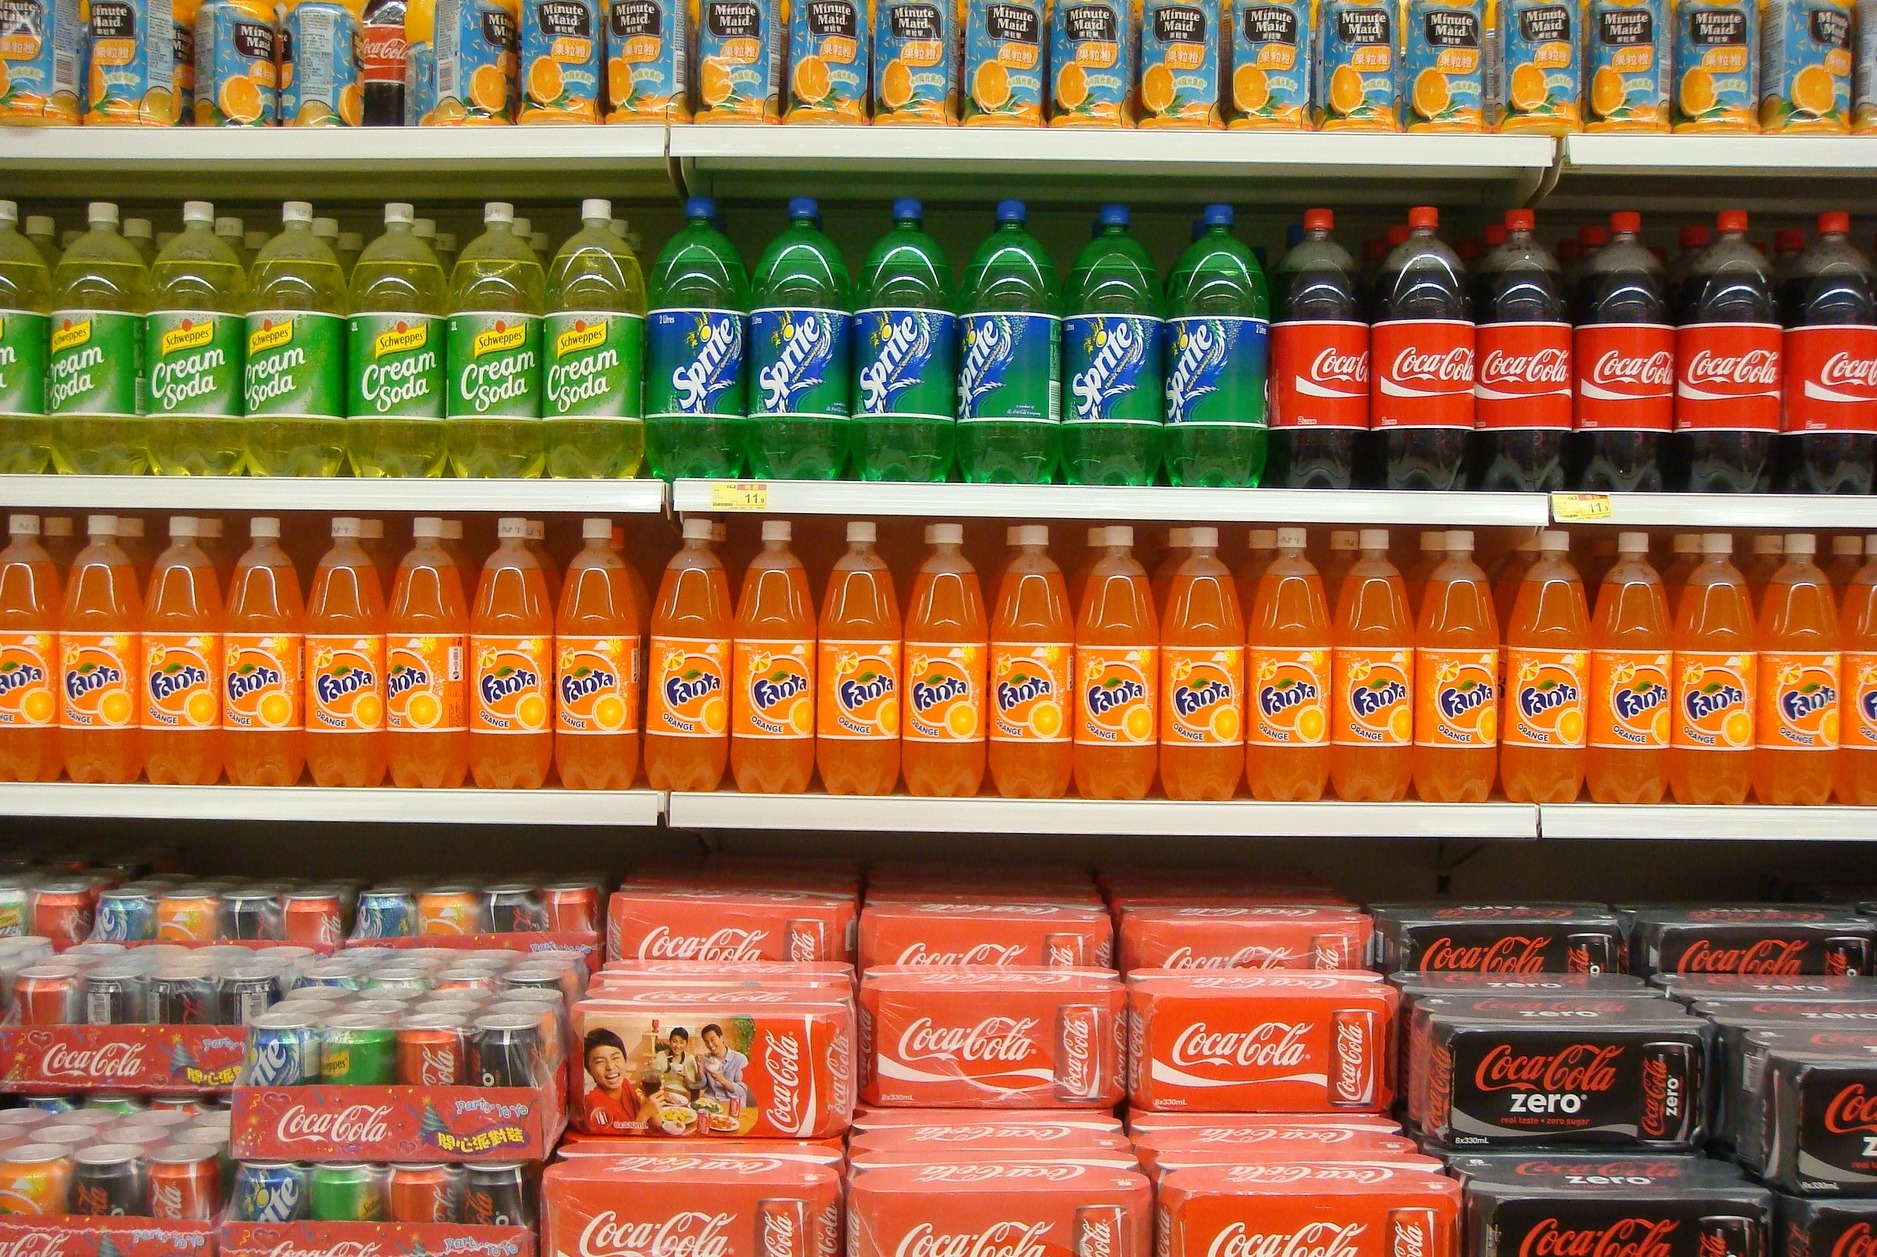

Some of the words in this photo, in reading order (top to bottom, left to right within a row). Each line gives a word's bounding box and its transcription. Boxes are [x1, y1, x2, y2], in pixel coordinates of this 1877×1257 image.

[543, 5, 584, 15] Minute
[616, 4, 655, 14] Minute
[715, 5, 756, 15] Minute
[813, 4, 851, 14] Minute
[893, 7, 934, 18] Minute
[993, 7, 1033, 20] Minute
[1070, 8, 1110, 20] Minute
[1160, 9, 1200, 21] Minute
[1250, 10, 1292, 22] Minute
[1342, 12, 1386, 23] Minute
[1526, 10, 1566, 21] Minute
[1604, 13, 1648, 24] Minute
[1696, 13, 1741, 24] Minute
[549, 15, 579, 26] Maid
[620, 14, 649, 26] Maid
[719, 15, 750, 27] Maid
[817, 14, 846, 26] Maid
[898, 18, 928, 29] Maid
[997, 18, 1028, 30] Maid
[1074, 19, 1105, 30] Maid
[1163, 20, 1194, 31] Maid
[1255, 21, 1287, 32] Maid
[1349, 23, 1379, 35] Maid
[1430, 14, 1473, 25] Minute
[1531, 20, 1563, 32] Maid
[1435, 24, 1468, 36] Maid
[1609, 25, 1643, 35] Maid
[1700, 24, 1735, 35] Maid
[554, 45, 587, 57] 果粒橙
[1003, 50, 1034, 62] 果粒橙
[1168, 51, 1199, 63] 果粒橙
[1355, 54, 1389, 66] 果粒橙
[1616, 55, 1649, 66] 果粒橙
[1440, 56, 1473, 68] 果粒橙
[660, 315, 665, 324] 2
[165, 329, 210, 347] Schweppes
[251, 328, 288, 346] Schweppes
[379, 330, 424, 350] Schweppes
[478, 330, 523, 349] Schweppes
[560, 329, 605, 348] Schweppes
[672, 318, 733, 410] Sprite
[760, 315, 820, 408] Sprite
[860, 315, 918, 408] Sprite
[1073, 319, 1132, 411] Sprite
[1166, 319, 1215, 410] Sprite
[1311, 347, 1369, 382] Coca-C
[1481, 347, 1568, 384] Coca-Cola
[1688, 350, 1777, 384] Coca-Cola
[1821, 352, 1877, 386] Coca-C
[152, 348, 226, 399] Cream
[245, 347, 306, 397] Cream
[362, 351, 436, 401] Cream
[461, 351, 536, 400] Cream
[547, 349, 619, 402] Cream
[164, 373, 217, 410] Soda
[250, 372, 296, 411] Soda
[377, 376, 430, 412] Soda
[475, 375, 528, 412] Soda
[558, 373, 610, 412] Soda
[66, 664, 120, 700] Fanta
[150, 665, 206, 701] Fanta
[227, 666, 279, 702] Fanta
[317, 668, 372, 704] Fanta
[481, 669, 536, 704] Fanta
[562, 669, 614, 705] Fanta
[666, 672, 720, 707] Fanta
[753, 674, 807, 709] Fanta
[840, 675, 893, 710] Fanta
[913, 677, 967, 712] Fanta
[997, 677, 1050, 711] Fanta
[1089, 680, 1143, 715] Fanta
[1175, 680, 1230, 716] Fanta
[1261, 681, 1316, 716] Fanta
[1352, 681, 1406, 717] Fanta
[1440, 683, 1492, 718] Fanta
[1520, 683, 1577, 718] Fanta
[1686, 686, 1742, 720] Fanta
[64, 706, 92, 724] ORANGE
[148, 706, 178, 724] ORANGE
[316, 710, 346, 727] ORANGE
[480, 711, 509, 728] ORANGE
[663, 713, 694, 731] ORANGE
[751, 716, 783, 733] ORANGE
[838, 717, 870, 734] ORANGE
[1086, 723, 1117, 740] ORANGE
[1258, 722, 1288, 740] ORANGE
[1350, 723, 1382, 741] ORANGE
[1517, 723, 1549, 742] ORANGE
[1612, 725, 1647, 743] ORANGE
[1779, 727, 1814, 745] ORANGE
[639, 926, 769, 961] Coca-Cola
[1420, 936, 1552, 973] Coca-Cola
[1677, 939, 1809, 975] Coca-Cola
[898, 1017, 1039, 1061] Coca-Cola
[1172, 1022, 1315, 1067] Coca-Cola
[42, 1042, 146, 1077] Coca-Cola
[1062, 1015, 1088, 1096] Coca-Cola
[1336, 1020, 1363, 1101] Coca-Cola
[1475, 1044, 1625, 1092] Coca-Cola
[766, 1029, 800, 1134] Coca-Cola
[881, 1093, 914, 1101] 8x330mL
[1510, 1094, 1581, 1113] zero
[1642, 1057, 1668, 1136] Coca-Cola
[1666, 1079, 1678, 1117] zero
[277, 1105, 393, 1143] Coca-Cola
[1501, 1117, 1518, 1125] real
[1522, 1117, 1538, 1125] taste
[1566, 1118, 1590, 1127] sugar
[437, 1127, 525, 1153] 開心派對裝
[1455, 1136, 1489, 1145] 8x330mL
[913, 1165, 1086, 1182] Coca-Cola
[1225, 1166, 1393, 1184] Coca-Cola
[1565, 1175, 1652, 1185] zero
[579, 1210, 737, 1257] Coca-Cola
